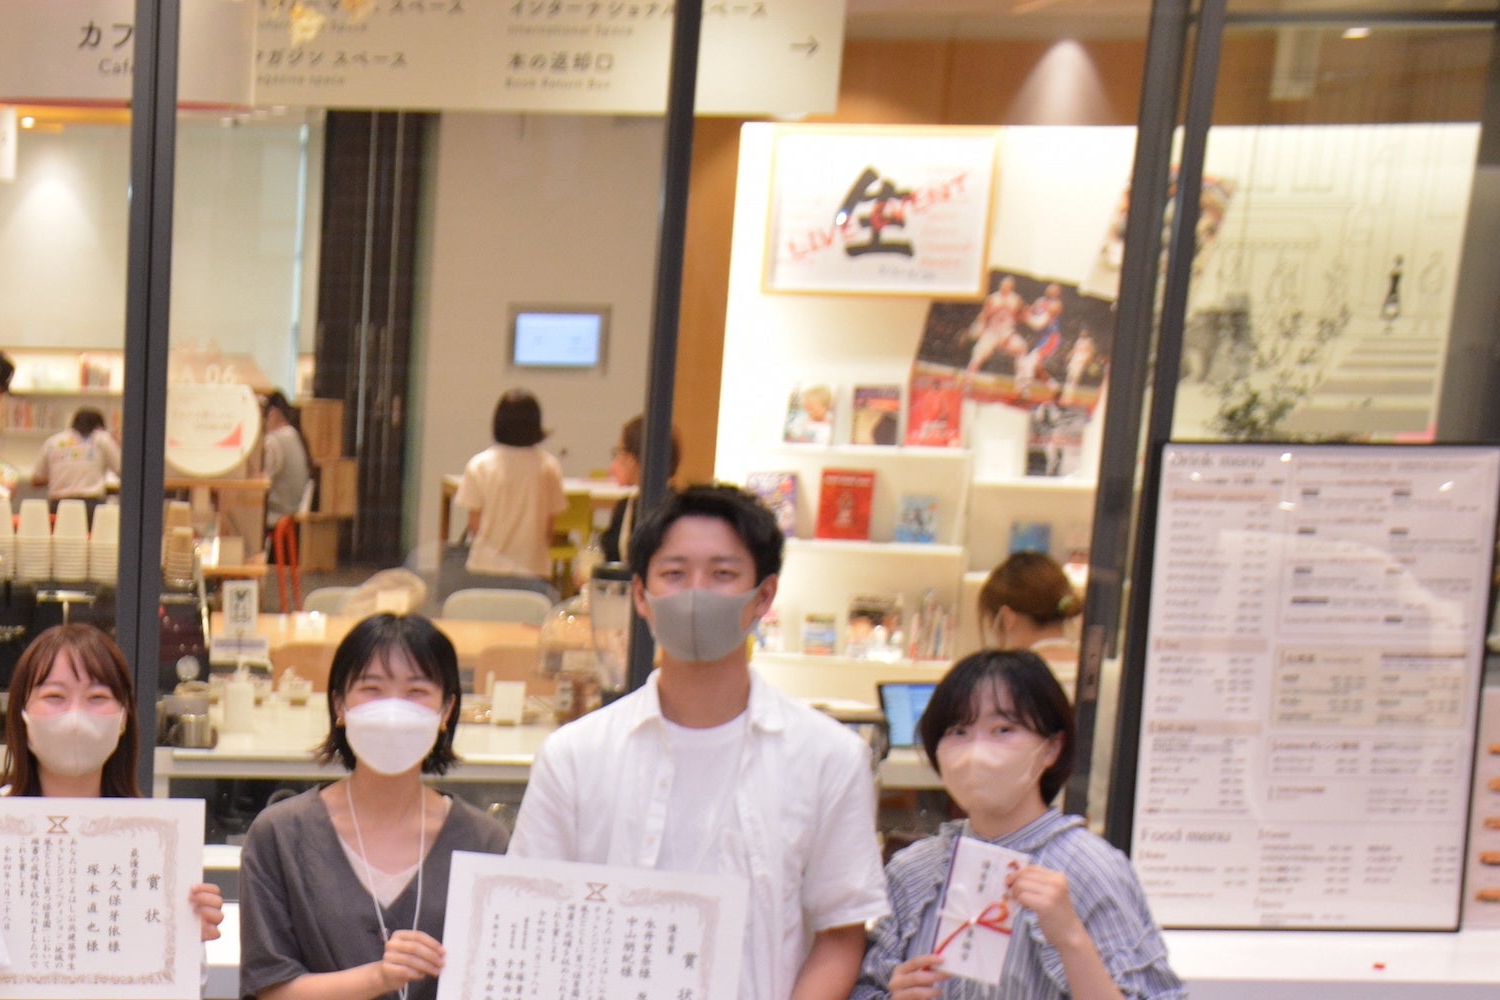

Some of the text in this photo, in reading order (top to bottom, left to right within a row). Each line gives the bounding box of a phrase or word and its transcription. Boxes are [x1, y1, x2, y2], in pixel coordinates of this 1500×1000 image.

[129, 847, 140, 889] 最優秀賞
[144, 873, 161, 923] 賞状
[85, 863, 101, 953] 塚本直也様
[107, 863, 123, 953] 大久保芽依様
